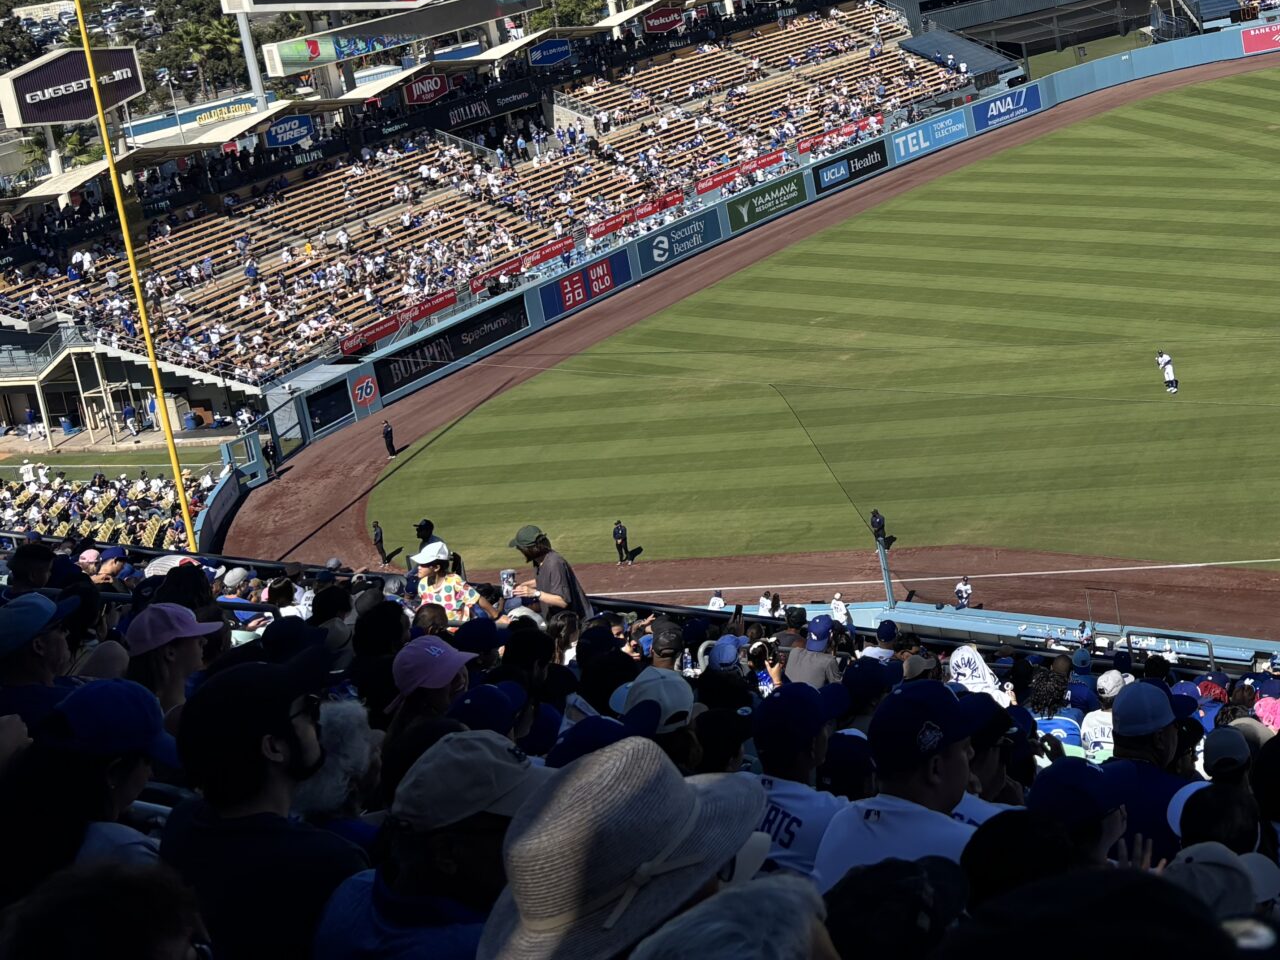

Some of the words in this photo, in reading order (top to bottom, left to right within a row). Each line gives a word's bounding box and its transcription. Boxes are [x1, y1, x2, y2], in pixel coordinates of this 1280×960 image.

[647, 12, 681, 27] Yakult
[1250, 26, 1271, 36] BANK
[412, 77, 441, 99] JINRO
[197, 106, 229, 123] GOLDEN
[231, 103, 252, 114] ROAD
[450, 100, 491, 126] BULLPEN
[497, 92, 527, 107] Spectrum
[988, 95, 1013, 118] ANA
[270, 120, 299, 136] TOYO
[933, 118, 953, 131] TOKYO
[935, 122, 965, 139] ELECTRON
[276, 126, 308, 143] TIRES
[895, 133, 930, 158] TEL
[823, 165, 846, 182] UCLA
[850, 151, 881, 172] Health
[755, 200, 774, 213] RESORT
[779, 191, 798, 204] CASINO
[670, 219, 705, 241] Security
[673, 234, 702, 255] Benefit
[589, 265, 608, 280] UNI
[592, 276, 611, 293] QLO
[389, 335, 455, 384] BULLPEN
[461, 316, 508, 345] Spectrum
[356, 381, 375, 400] 76
[425, 646, 444, 657] LA
